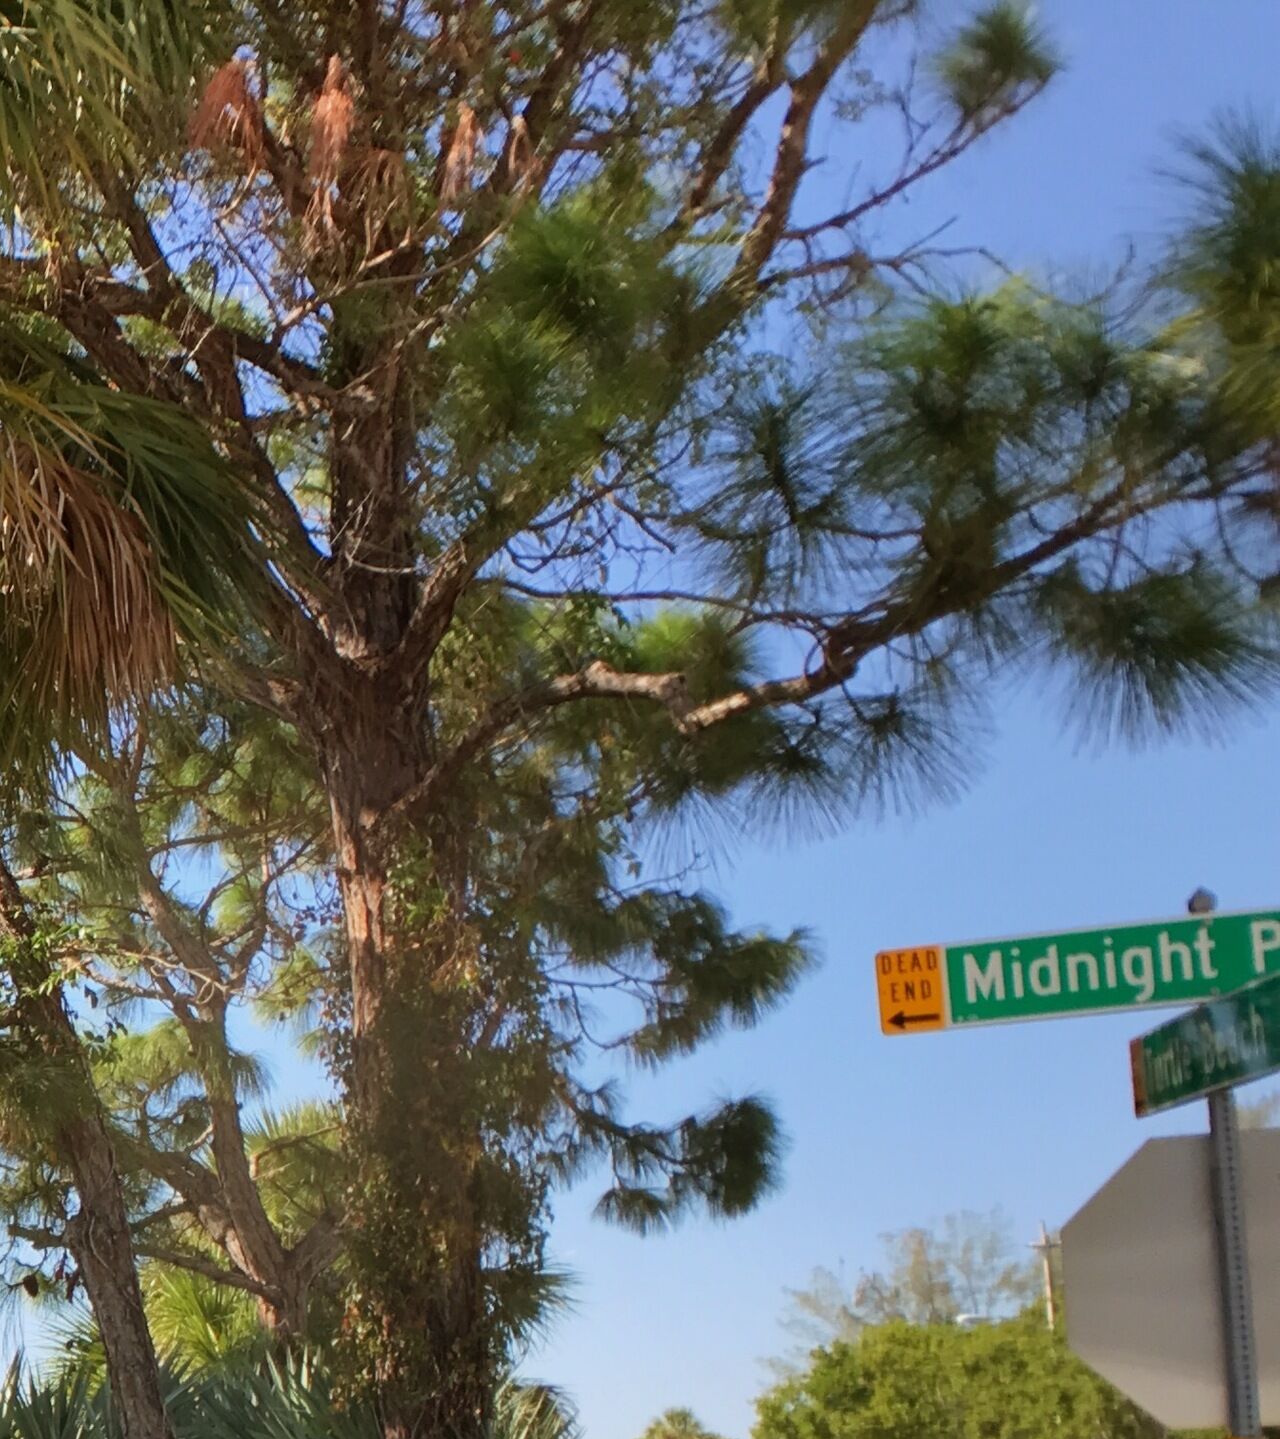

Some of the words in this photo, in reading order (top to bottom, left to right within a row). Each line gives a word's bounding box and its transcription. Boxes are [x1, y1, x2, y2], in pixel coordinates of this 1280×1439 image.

[880, 950, 938, 976] DEAD
[964, 927, 1218, 1001] Midnight
[889, 980, 933, 1004] END
